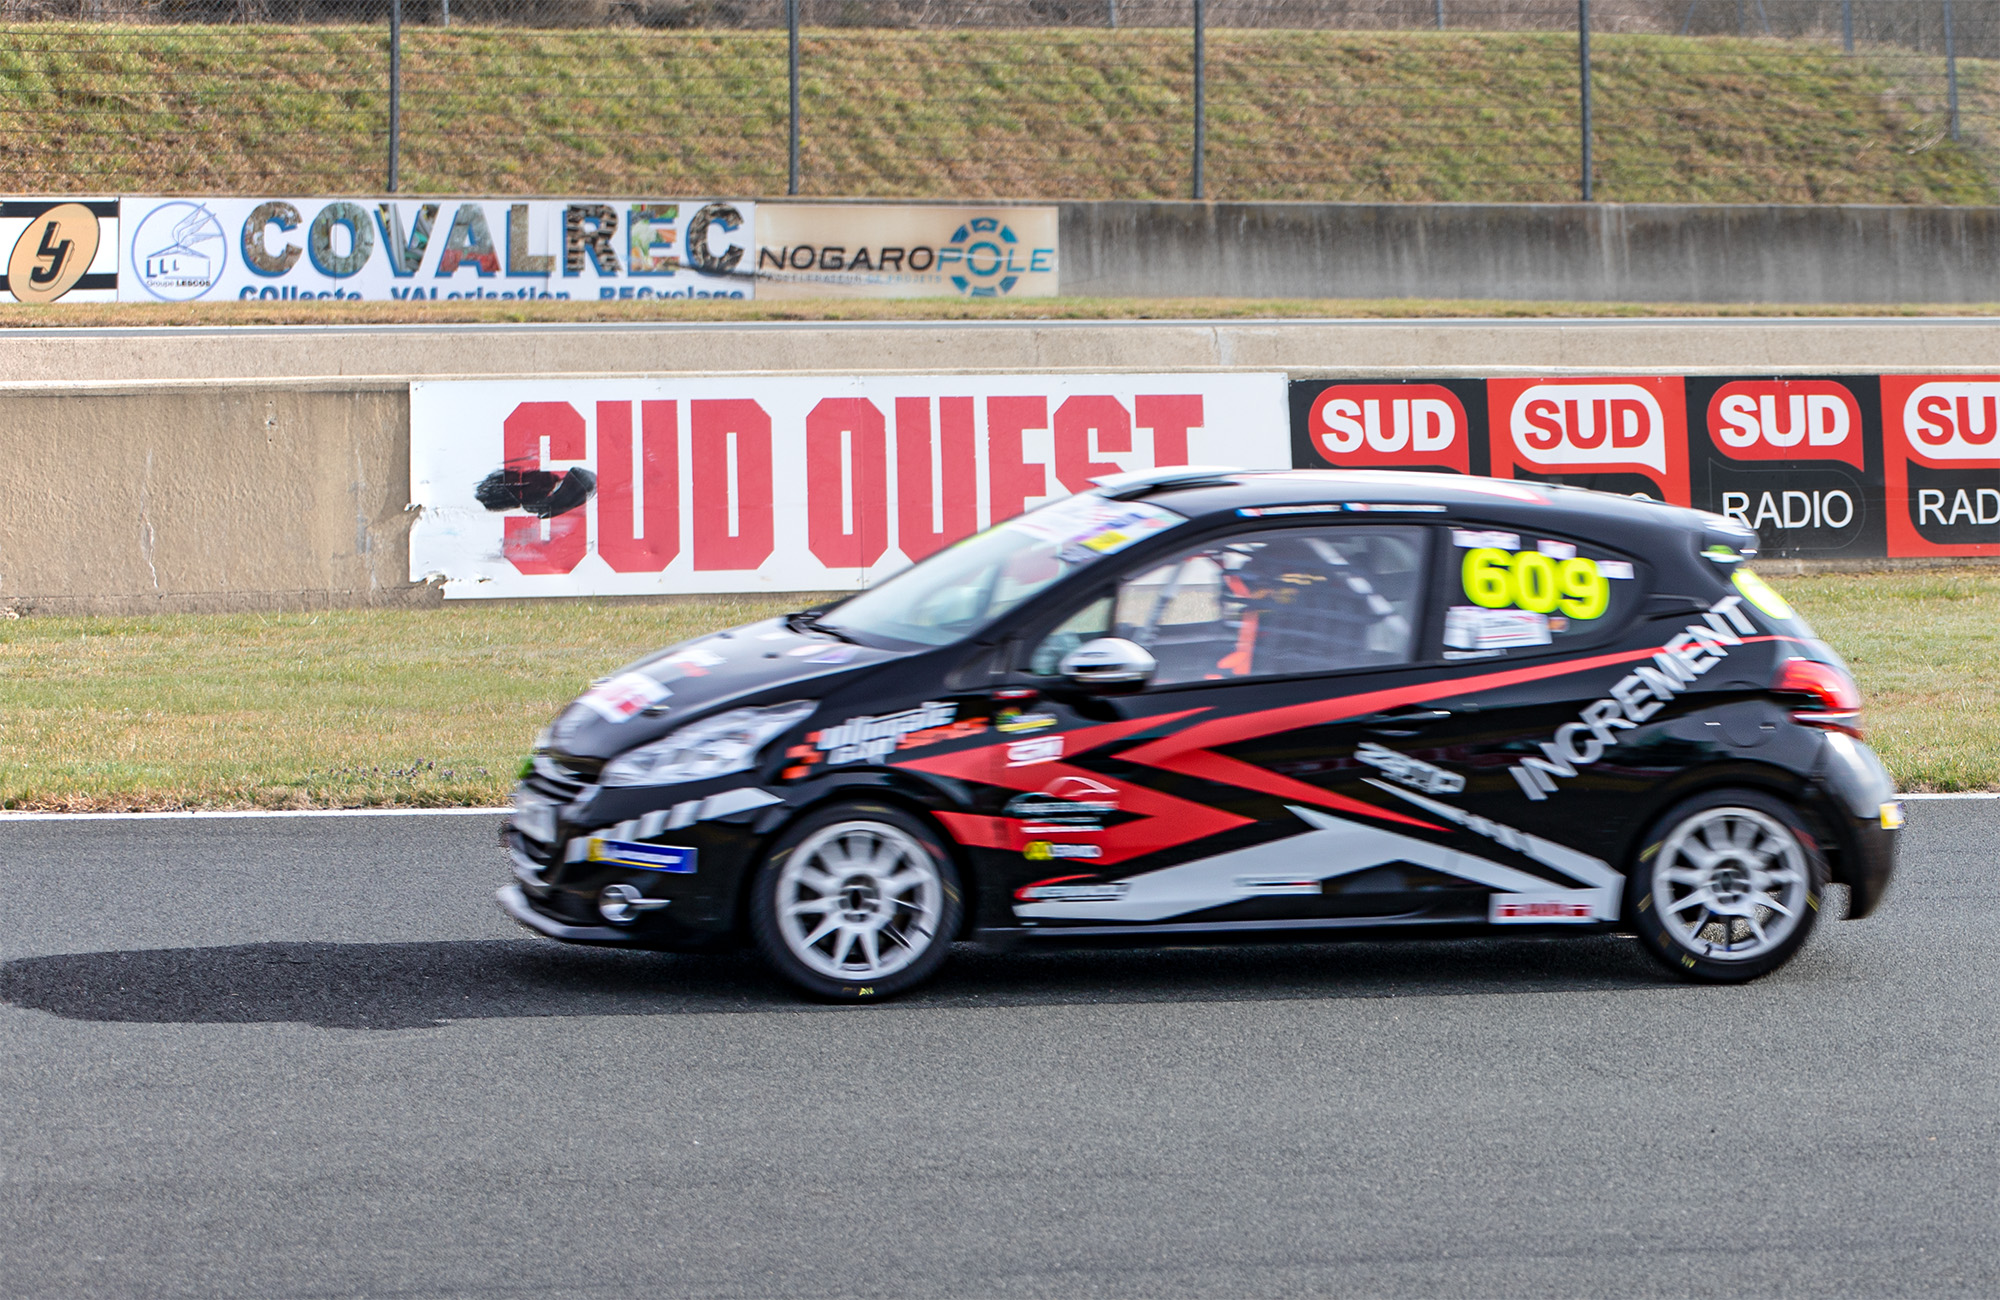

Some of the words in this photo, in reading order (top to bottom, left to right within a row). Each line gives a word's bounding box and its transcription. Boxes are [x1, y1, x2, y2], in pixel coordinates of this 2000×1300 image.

[241, 201, 745, 278] COVALREC
[1321, 397, 1456, 453] SUD
[1524, 398, 1651, 450] SUD
[1719, 394, 1851, 447] SUD
[503, 398, 775, 575] SUD
[1722, 489, 1854, 529] RADIO
[1461, 546, 1610, 620] 609
[1508, 595, 1758, 801] INCREMENT
